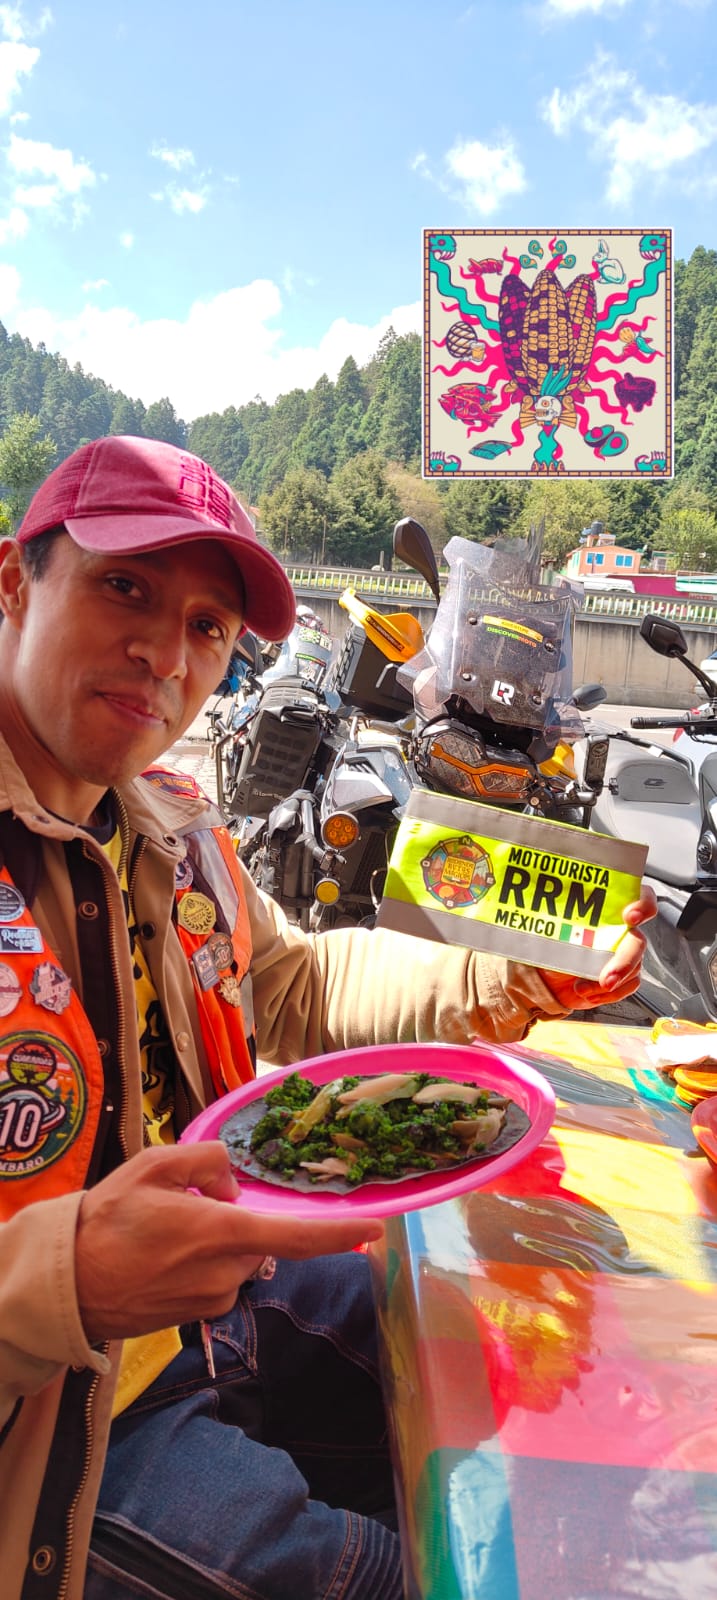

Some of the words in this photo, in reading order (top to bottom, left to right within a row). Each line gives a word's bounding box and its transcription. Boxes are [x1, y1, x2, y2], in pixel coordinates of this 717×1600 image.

[508, 847, 610, 887] MOTOTURISTA
[499, 865, 608, 927] RRM
[495, 908, 555, 937] MÉXICO
[0, 1100, 42, 1148] 10
